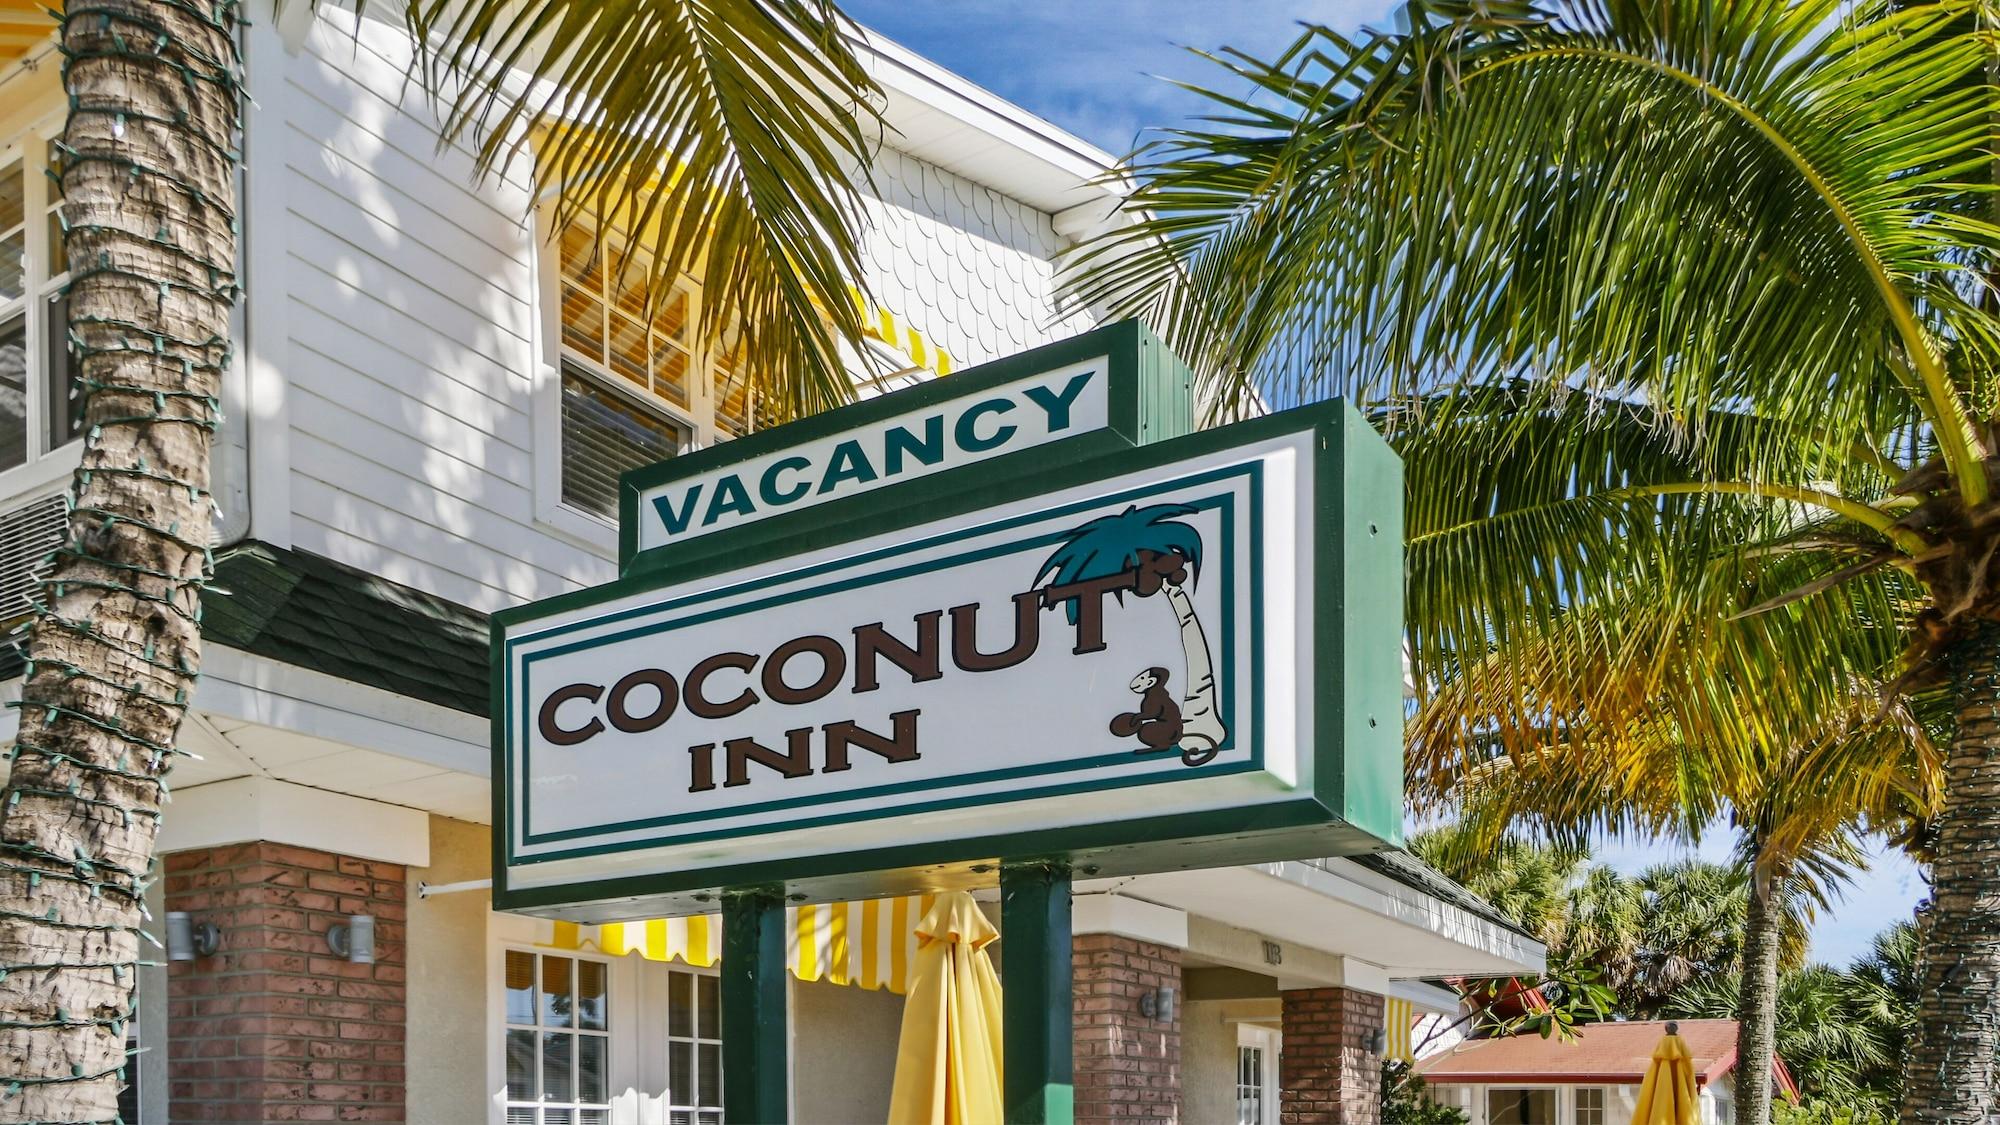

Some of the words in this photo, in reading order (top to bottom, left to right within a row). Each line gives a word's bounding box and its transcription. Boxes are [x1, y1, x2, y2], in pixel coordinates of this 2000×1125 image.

[652, 371, 1095, 536] VACANCY
[538, 566, 1140, 746] COCONUT
[688, 709, 923, 793] INN
